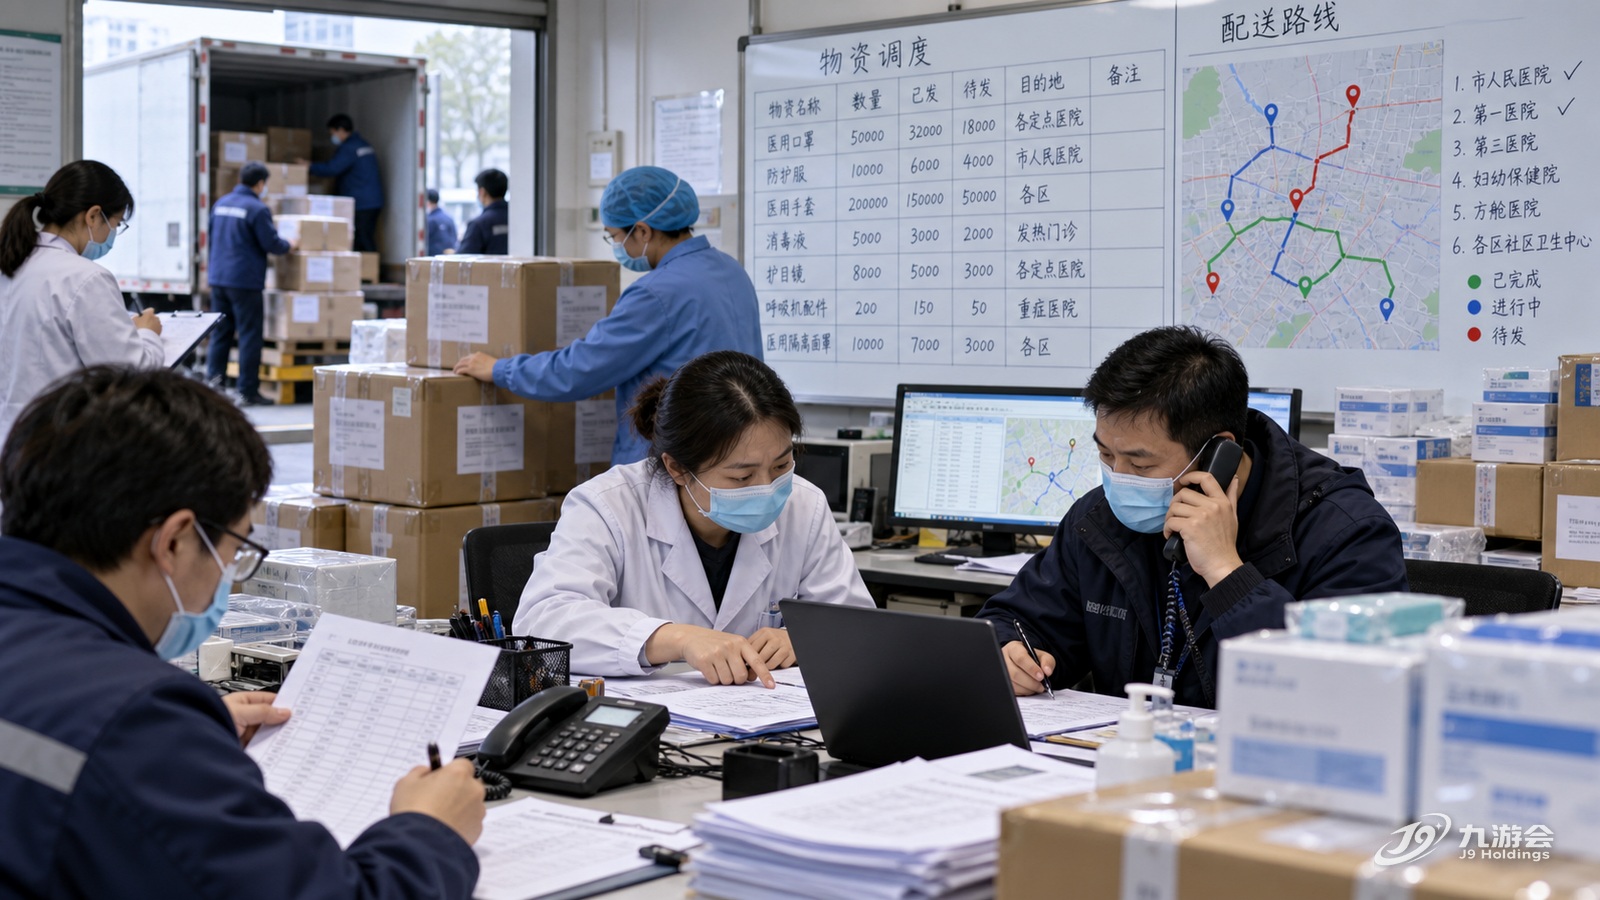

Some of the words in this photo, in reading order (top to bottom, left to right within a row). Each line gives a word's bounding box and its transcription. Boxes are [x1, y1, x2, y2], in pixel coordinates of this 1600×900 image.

[1222, 1, 1339, 43] 配送路线
[820, 36, 931, 75] 物资调度
[769, 97, 821, 118] 物资名称
[852, 89, 881, 111] 数量
[964, 79, 992, 99] 待发
[1022, 72, 1064, 93] 目的地
[1107, 64, 1141, 85] 备注
[768, 130, 814, 153] 医用口罩
[851, 130, 884, 145] 50000
[909, 125, 942, 140] 32000
[963, 119, 995, 134] 18000
[1015, 108, 1083, 131] 各定点医院
[767, 165, 807, 185] 防护服
[852, 163, 883, 178] 10000
[911, 157, 939, 174] 6000
[963, 154, 993, 169] 4000
[1017, 145, 1083, 169] 市人民医院
[768, 197, 815, 217] 医用手套
[849, 197, 888, 211] 200000
[907, 193, 944, 207] 150000
[963, 190, 996, 205] 50000
[1020, 185, 1050, 204] 各区
[767, 231, 807, 251] 消毒液
[853, 231, 881, 246] 5000
[911, 228, 939, 244] 3000
[964, 227, 993, 241] 2000
[1018, 221, 1077, 242] 发热门诊
[767, 264, 805, 284] 护目镜
[853, 265, 881, 281] 8000
[911, 264, 939, 279] 5000
[965, 263, 993, 279] 3000
[1016, 259, 1085, 279] 各定点医院
[766, 298, 827, 318] 呼吸机配件
[855, 301, 877, 315] 200
[914, 300, 933, 315] 150
[972, 300, 986, 316] 50
[1019, 298, 1078, 319] 重症医院
[1492, 297, 1540, 318] 进行中
[853, 337, 884, 351] 10000
[911, 337, 939, 352] 7000
[965, 338, 994, 353] 3000
[1021, 336, 1050, 356] 各区
[1492, 326, 1526, 345] 待发
